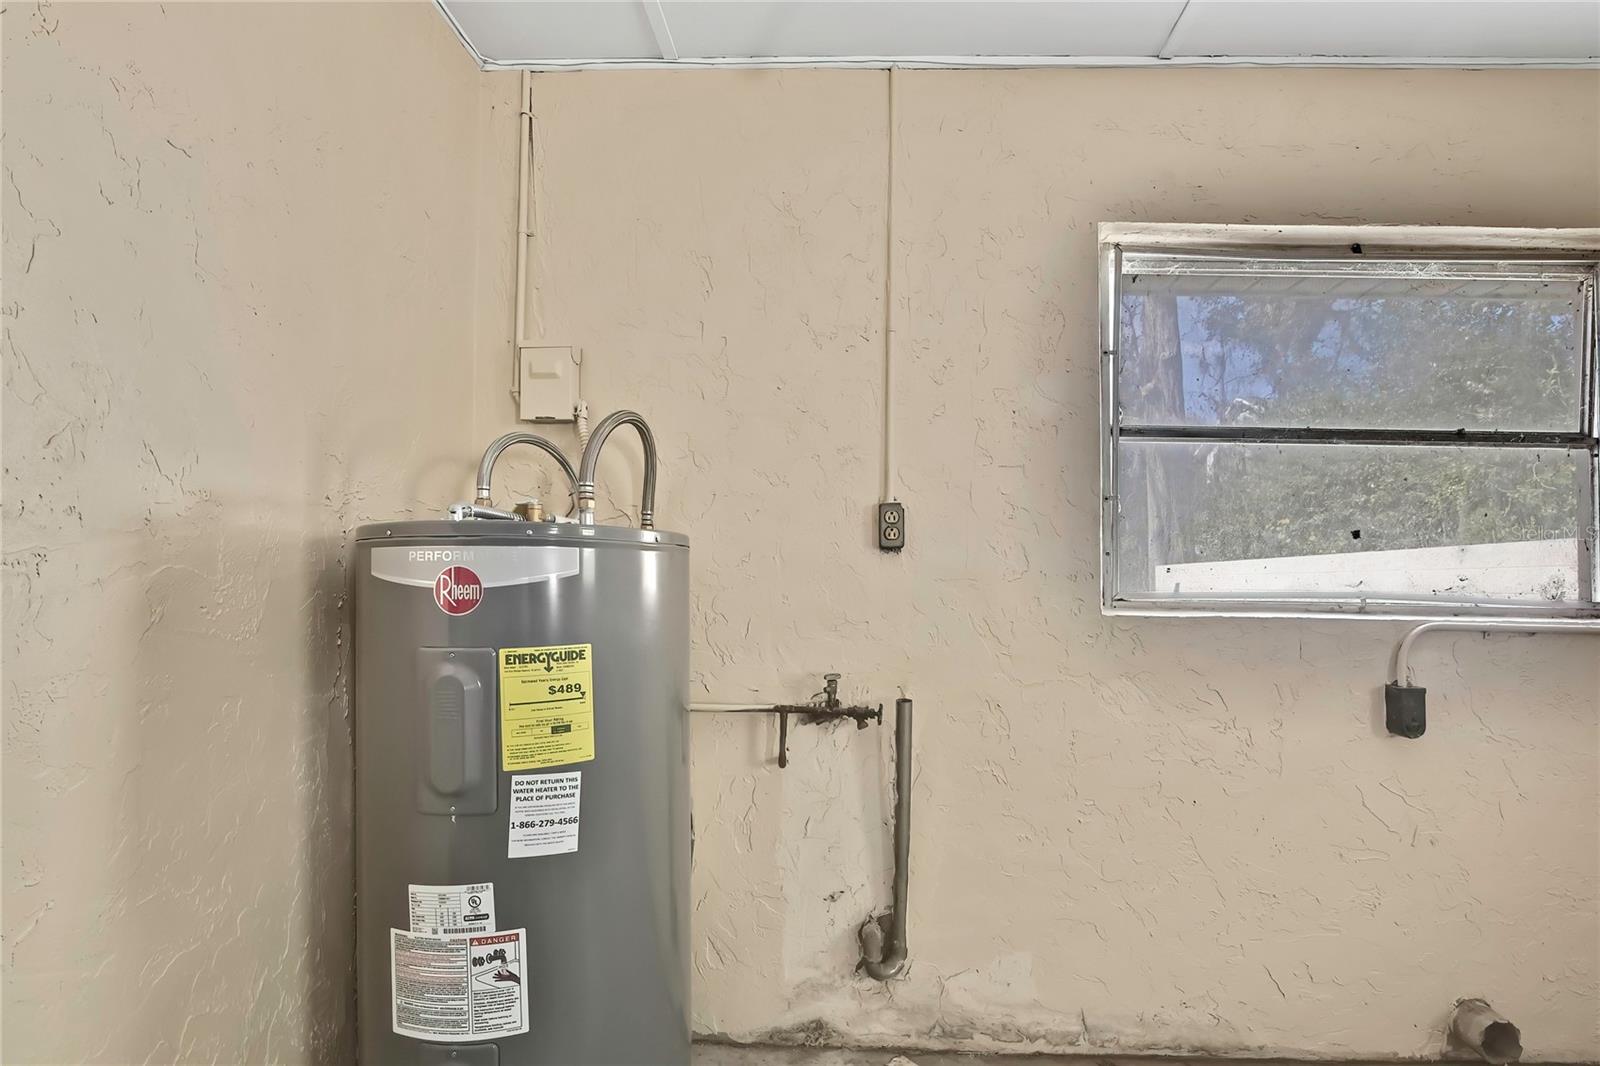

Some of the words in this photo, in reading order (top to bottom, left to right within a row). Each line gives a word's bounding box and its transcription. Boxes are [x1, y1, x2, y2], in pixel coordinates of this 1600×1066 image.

[440, 566, 480, 607] Rheem
[505, 649, 586, 667] ENERGYGUIDE
[548, 683, 582, 695] $489
[545, 792, 576, 800] PURCHASE
[510, 816, 579, 830] 1-866-279-4566
[481, 935, 517, 944] DANGER
